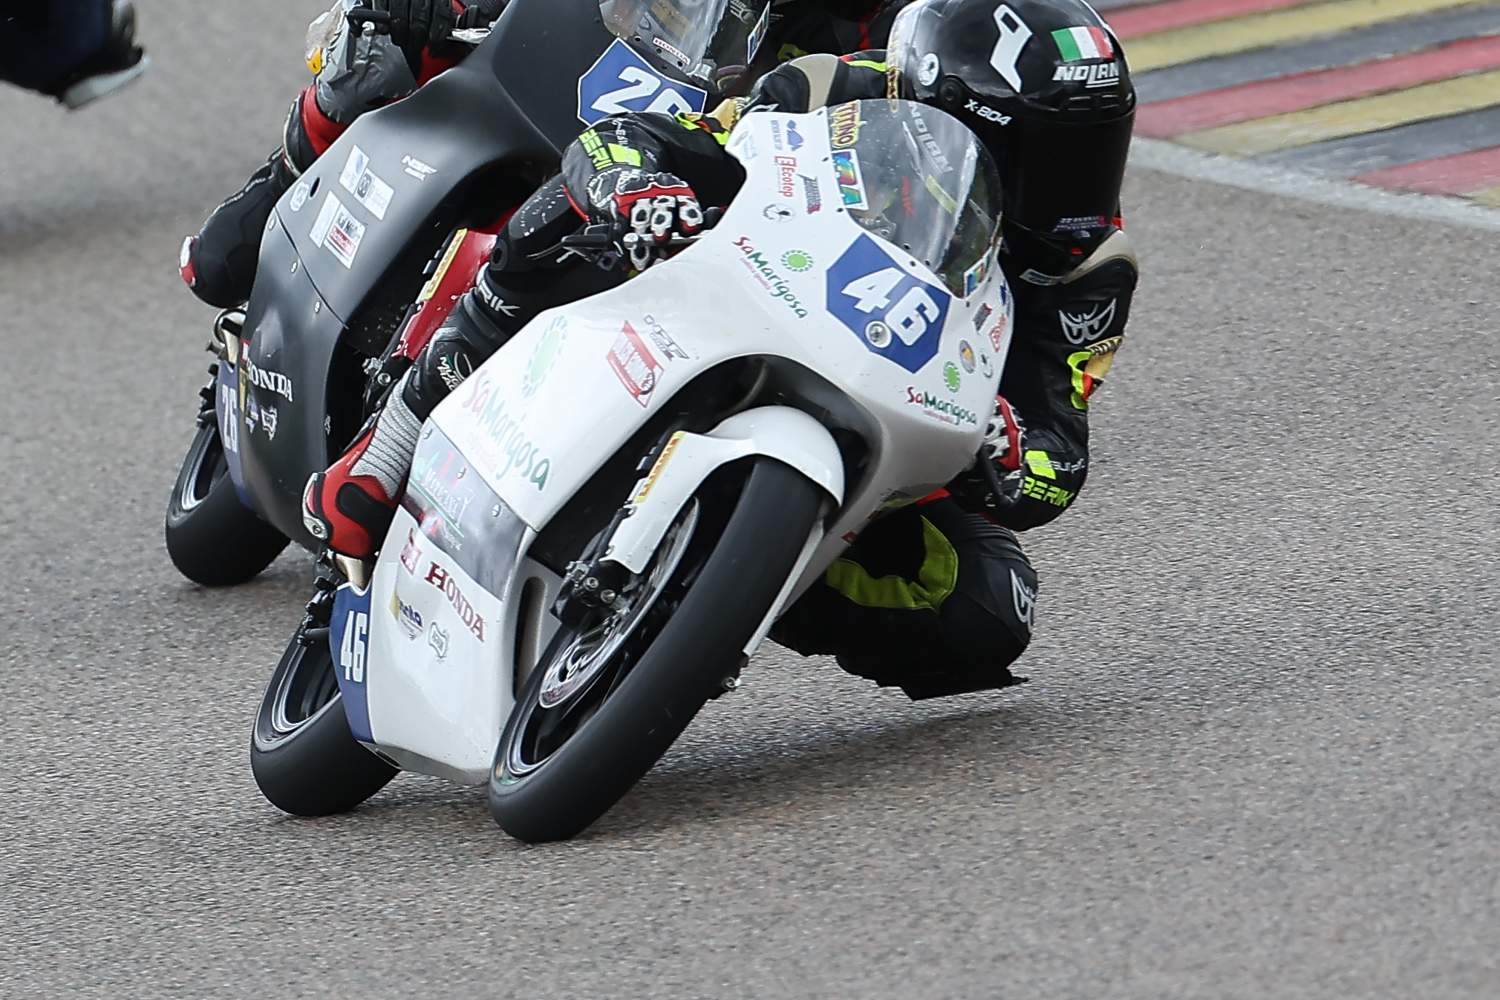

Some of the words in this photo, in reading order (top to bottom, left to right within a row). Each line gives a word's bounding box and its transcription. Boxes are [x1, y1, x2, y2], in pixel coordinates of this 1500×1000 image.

[653, 38, 690, 64] HONDA
[1051, 62, 1120, 88] NOLAN
[831, 99, 863, 147] TITINO
[964, 98, 1012, 126] X-804
[578, 128, 614, 171] BERI
[908, 101, 954, 175] NOLAN
[401, 154, 438, 175] NSF
[732, 236, 809, 319] SaMarigosa
[841, 267, 940, 346] 46
[247, 358, 293, 402] HONDA
[221, 383, 238, 453] 26
[907, 386, 977, 426] SaMarigosa
[462, 369, 550, 491] SaMarigosa
[1022, 475, 1075, 508] BERIK
[424, 561, 486, 643] HONDA
[339, 609, 368, 684] 46
